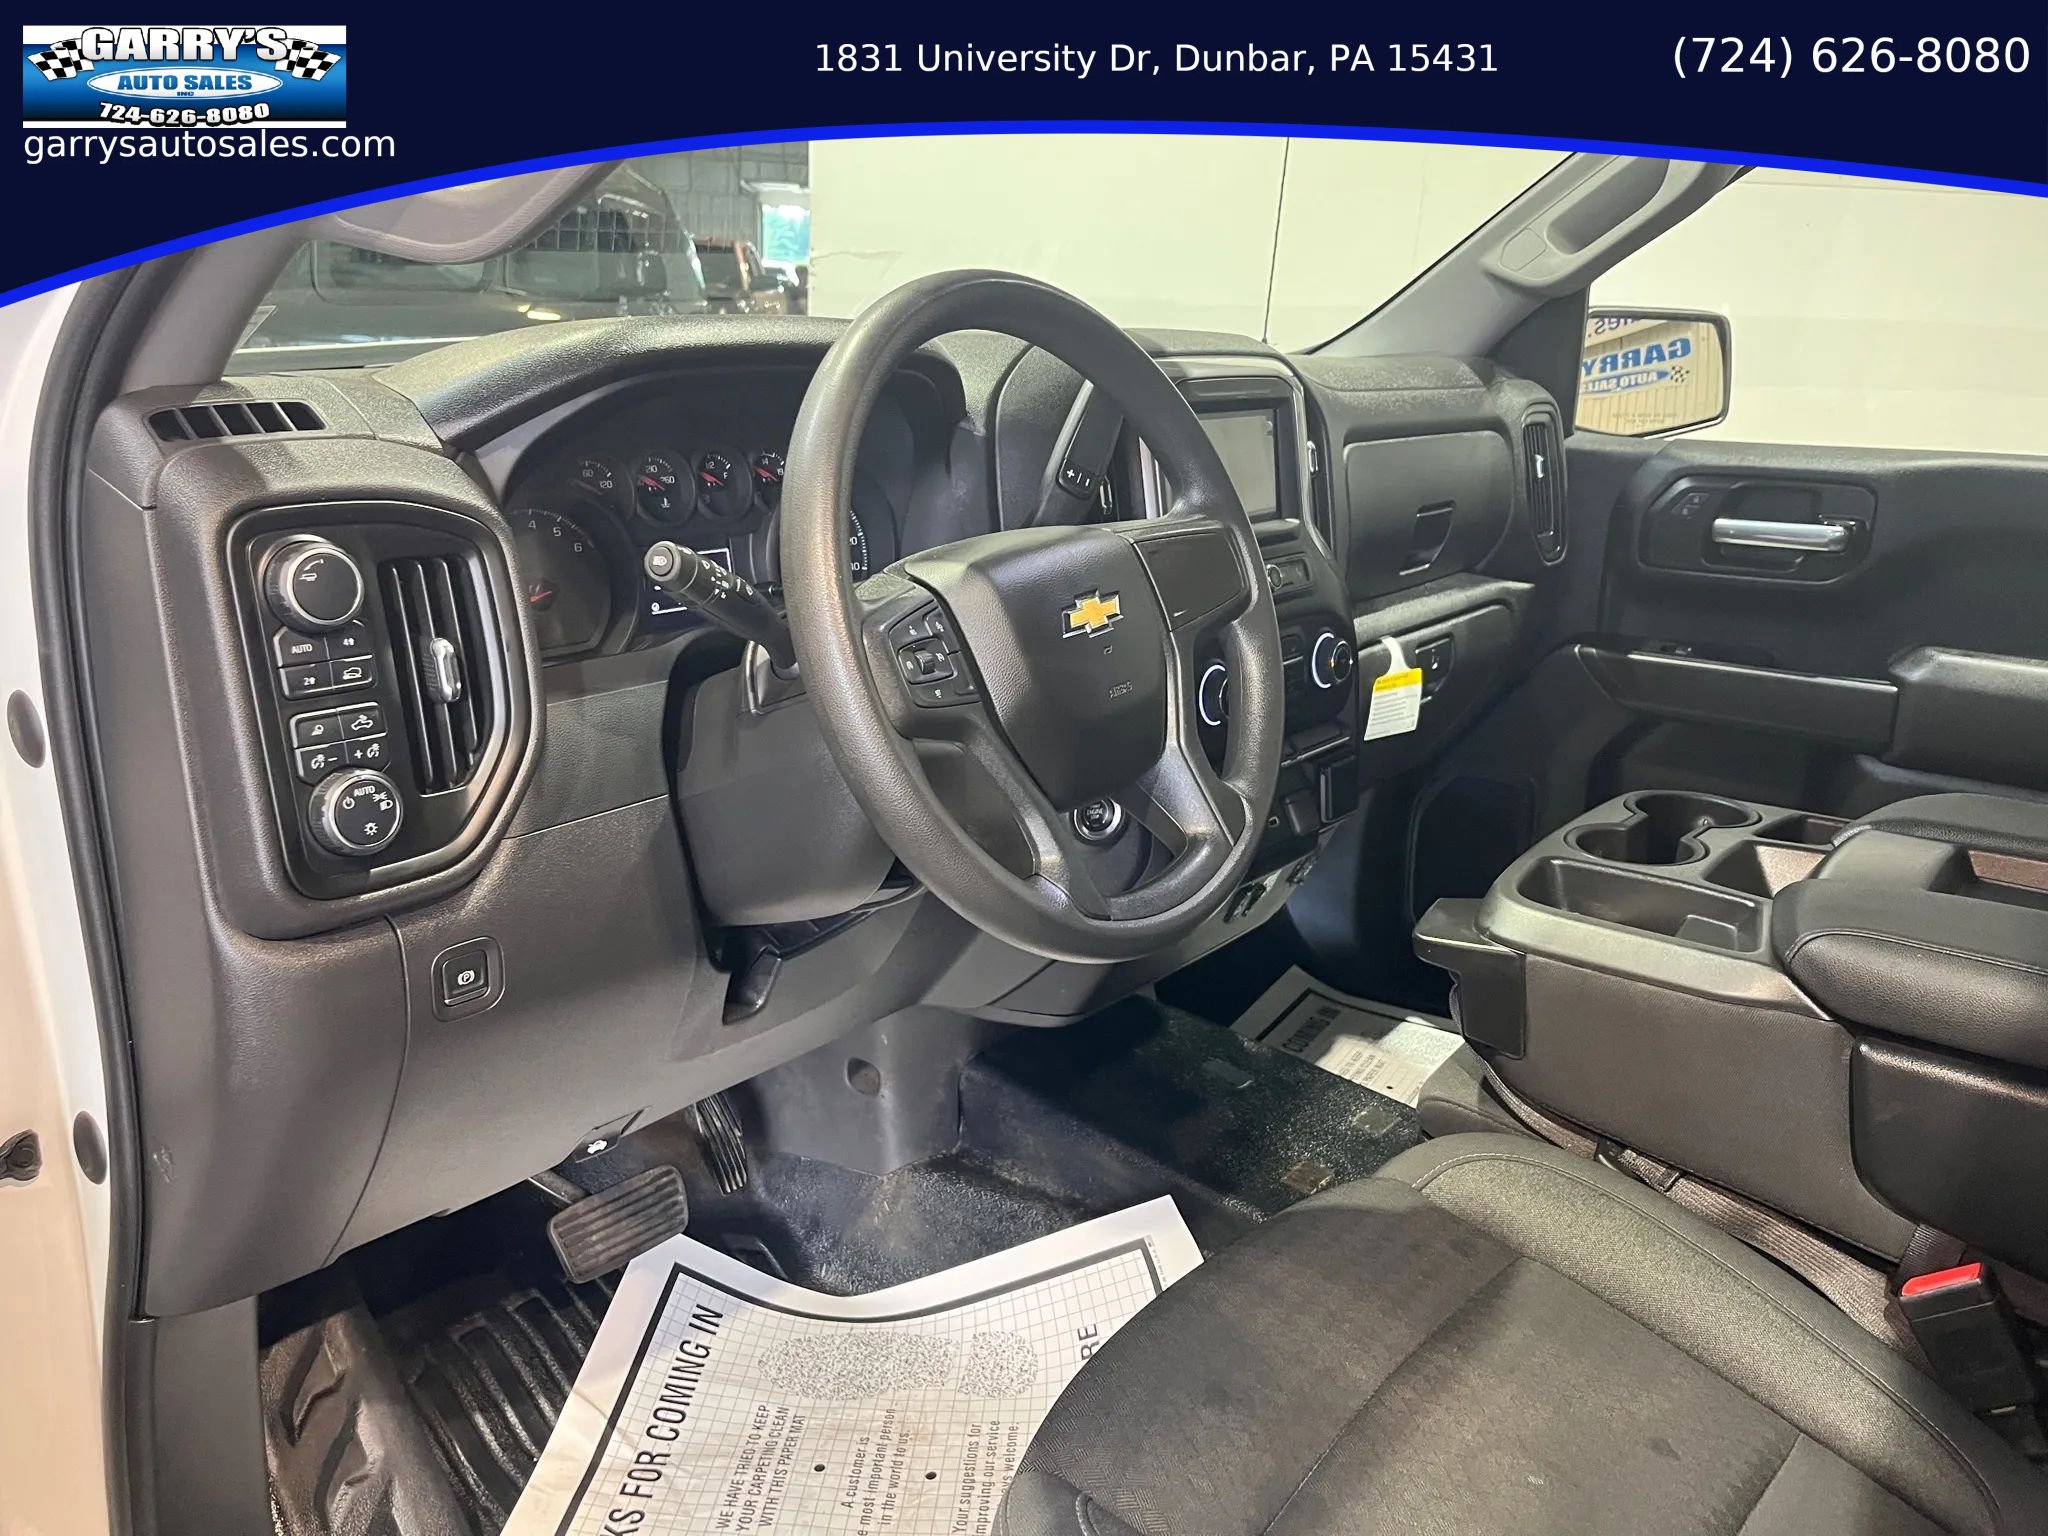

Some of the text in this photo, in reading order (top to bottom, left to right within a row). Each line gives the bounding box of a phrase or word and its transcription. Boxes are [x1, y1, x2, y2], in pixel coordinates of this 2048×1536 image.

[528, 520, 537, 530] 4
[553, 527, 562, 537] 5
[574, 542, 583, 553] 6
[291, 643, 313, 654] AUTO
[353, 785, 375, 797] AUTO
[620, 1451, 671, 1498] FOR
[646, 1339, 711, 1441] COMING
[688, 1303, 723, 1335] IN
[893, 1446, 906, 1457] to
[715, 1404, 770, 1529] WE HAVE TRIED TO KEEP
[736, 1406, 789, 1531] YOUR CARPETING CLEAN
[759, 1414, 806, 1527] WITH THIS PAPER MAT
[841, 1435, 870, 1509] A customer is
[860, 1497, 876, 1526] most
[880, 1408, 896, 1441] person
[888, 1461, 904, 1488] world
[952, 1424, 981, 1533] Your suggestions for
[973, 1421, 1000, 1536] mproving our service
[881, 1493, 896, 1510] the
[877, 1515, 892, 1525] in
